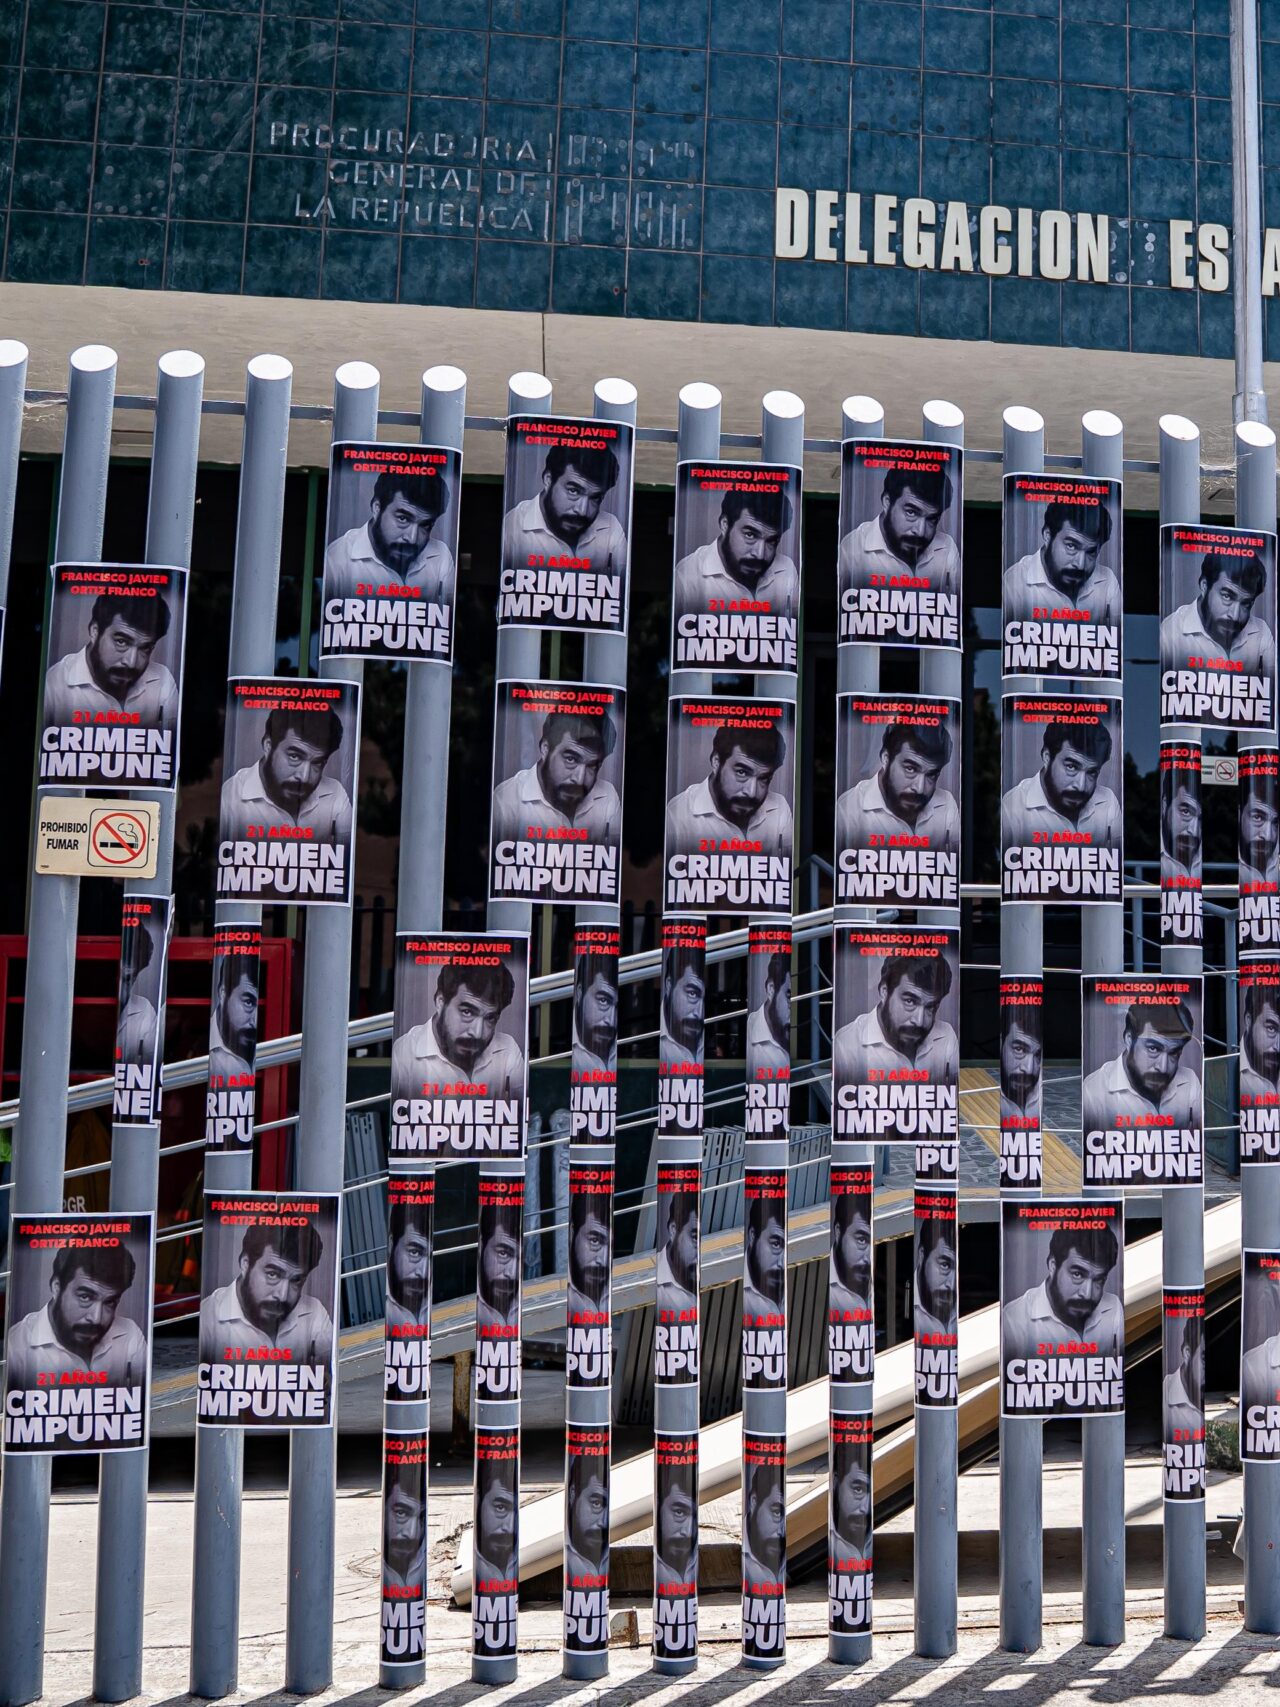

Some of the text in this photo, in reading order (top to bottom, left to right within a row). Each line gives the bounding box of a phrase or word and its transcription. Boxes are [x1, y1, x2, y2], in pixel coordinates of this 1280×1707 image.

[295, 192, 336, 219] LA
[775, 187, 1109, 283] DELEGACION
[344, 449, 446, 465] FRANCISCO JAVIER
[389, 465, 435, 475] FRANCO
[1016, 480, 1108, 495] FRANCISCO JAVIER
[1057, 495, 1098, 505] FRANCO
[1174, 530, 1263, 546] FRANCISCO JAVIER
[1214, 547, 1253, 556] FRANCO
[61, 572, 167, 585] FRANCISCO JAVIER
[356, 583, 421, 597] 21 AÑOS
[500, 568, 620, 597] CRIMEN
[108, 586, 156, 596] FRANCO
[841, 587, 957, 615] CRIMEN
[324, 597, 450, 626] CRIMEN
[498, 592, 619, 622] IMPUNE
[1033, 607, 1090, 621] 21 AÑOS
[323, 622, 450, 651] IMPUNE
[677, 613, 796, 639] CRIMEN
[841, 611, 958, 638] IMPUNE
[1004, 620, 1117, 647] CRIMEN
[677, 637, 796, 663] IMPUNE
[1004, 643, 1118, 671] IMPUNE
[1188, 656, 1243, 672] 21 AÑOS
[1162, 669, 1269, 699] CRIMEN
[72, 710, 140, 724] 21 AÑOS
[682, 704, 782, 717] FRANCISCO JAVIER
[853, 701, 948, 714] FRANCISCO JAVIER
[1162, 692, 1270, 722] IMPUNE
[727, 718, 772, 728] FRANCO
[896, 715, 938, 726] FRANCO
[42, 726, 172, 752] CRIMEN
[40, 752, 171, 778] IMPUNE
[40, 821, 88, 834] PROHIBIDO
[46, 838, 79, 851] FUMAR
[699, 838, 762, 852] 21 AÑOS
[868, 833, 929, 847] 21 AÑOS
[218, 840, 344, 868] CRIMEN
[494, 840, 616, 869] CRIMEN
[838, 848, 956, 874] CRIMEN
[1004, 846, 1118, 869] CRIMEN
[668, 854, 789, 879] CRIMEN
[217, 866, 344, 893] IMPUNE
[494, 865, 615, 894] IMPUNE
[667, 879, 789, 904] IMPUNE
[838, 873, 956, 898] IMPUNE
[1004, 870, 1118, 893] IMPUNE
[1095, 983, 1189, 992] FRANCISCO JAVIER
[1138, 996, 1179, 1004] FRANCO
[837, 1084, 956, 1108] CRIMEN
[393, 1099, 518, 1124] CRIMEN
[838, 1110, 957, 1133] IMPUNE
[1115, 1113, 1174, 1127] 21 AÑOS
[392, 1125, 518, 1149] IMPUNE
[1086, 1129, 1200, 1154] CRIMEN
[1086, 1153, 1201, 1178] IMPUNE
[1019, 1207, 1114, 1217] FRANCISCO JAVIER
[20, 1223, 130, 1234] FRANCISCO JAVIER
[1062, 1220, 1106, 1229] FRANCO
[68, 1237, 119, 1247] FRANCO
[1037, 1340, 1097, 1355] 21 AÑOS
[37, 1369, 108, 1386] 21 AÑOS
[1007, 1357, 1122, 1382] CRIMEN
[5, 1386, 140, 1416] CRIMEN
[1007, 1381, 1123, 1407] IMPUNE
[5, 1413, 141, 1443] IMPUNE
